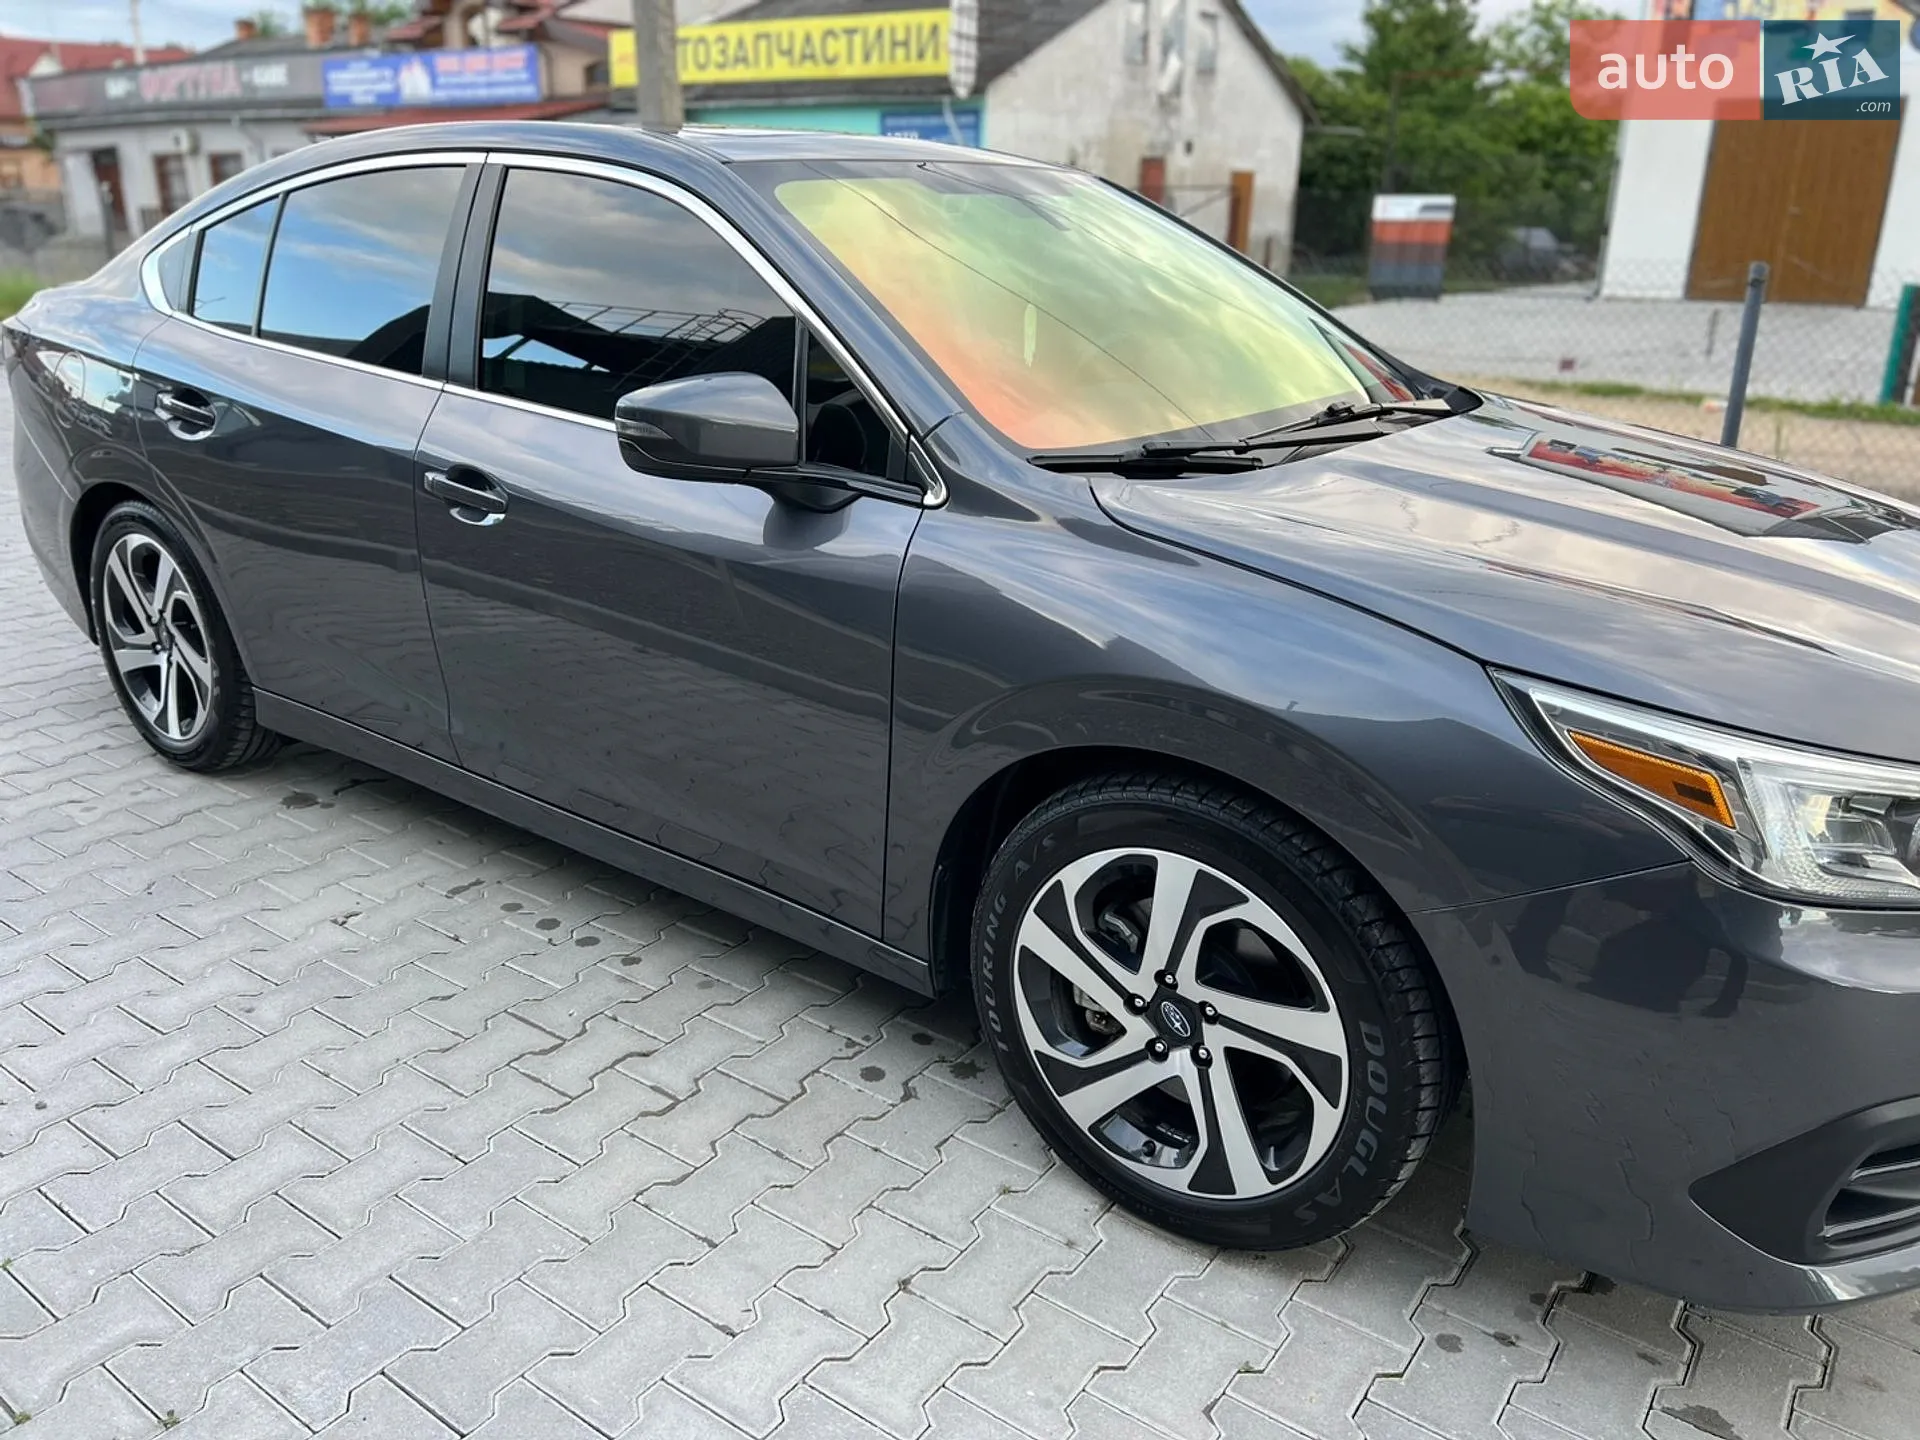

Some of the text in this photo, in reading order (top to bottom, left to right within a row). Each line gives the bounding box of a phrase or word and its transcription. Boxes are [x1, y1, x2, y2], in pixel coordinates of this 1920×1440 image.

[676, 22, 941, 71] ТОЗАПЧАСТИНИ
[982, 893, 1009, 1052] TOURING
[1294, 1019, 1388, 1226] DOUGLAS
